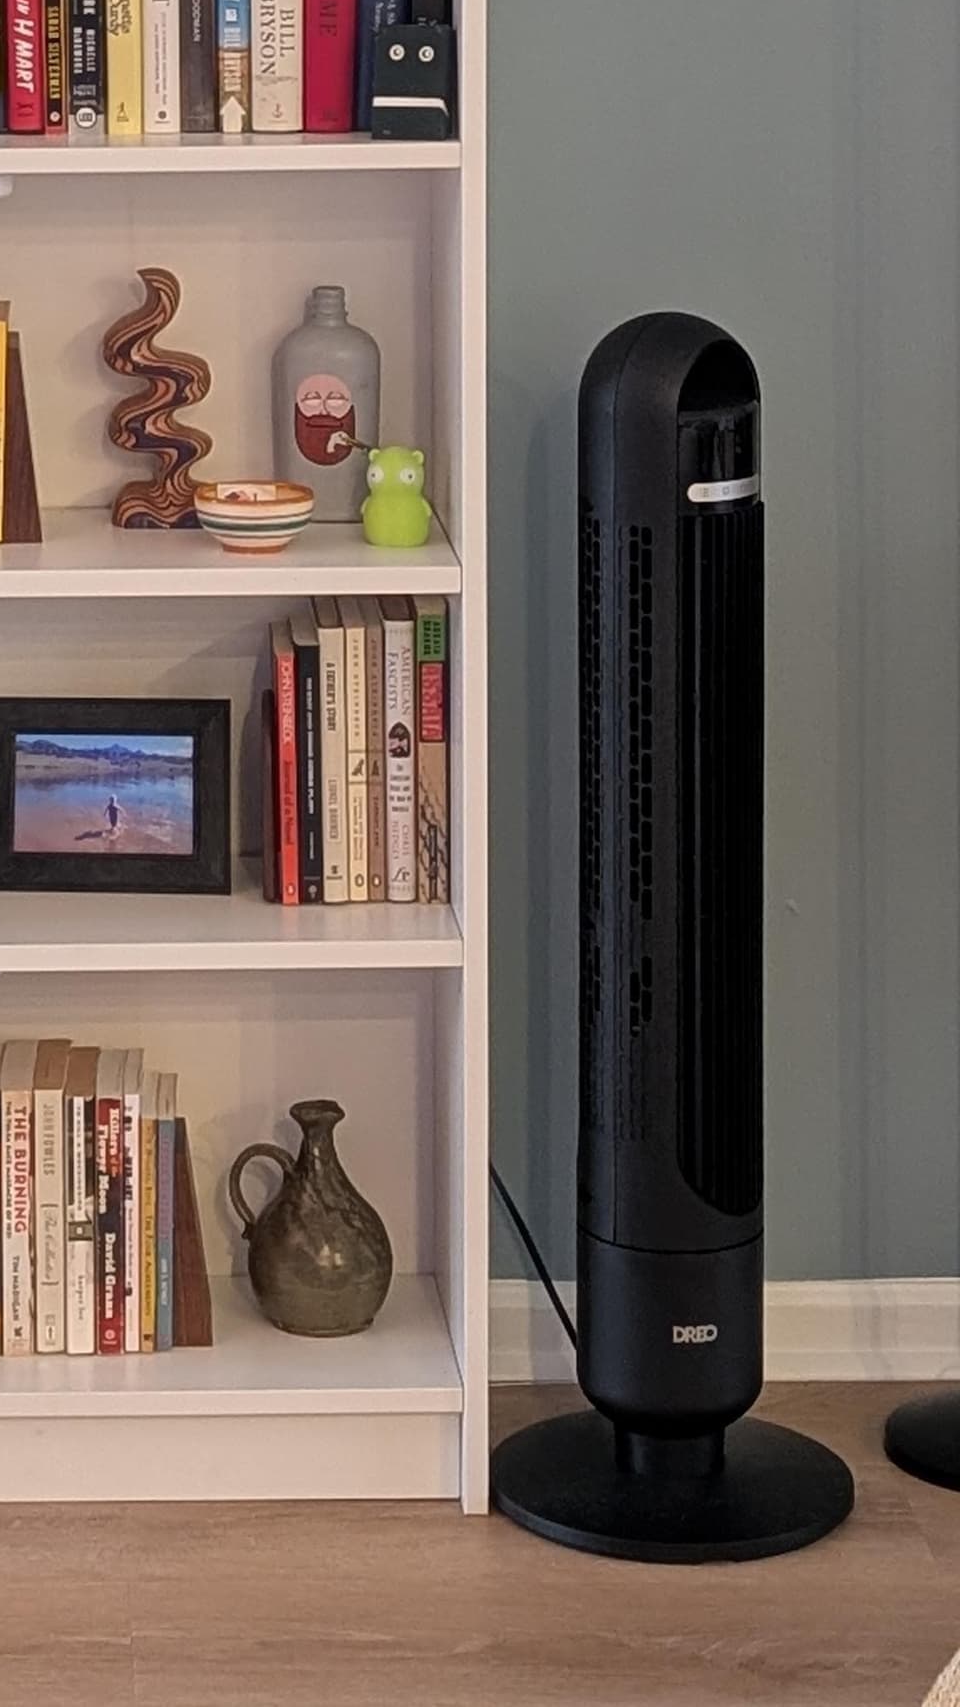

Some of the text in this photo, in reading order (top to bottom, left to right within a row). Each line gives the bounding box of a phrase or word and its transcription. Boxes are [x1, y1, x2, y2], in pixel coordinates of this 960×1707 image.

[14, 19, 33, 35] H
[223, 26, 241, 48] BILL
[279, 8, 295, 58] BILL
[16, 39, 34, 93] MART
[388, 651, 398, 711] FASCISTS
[401, 645, 412, 715] AMERICAN
[109, 1107, 120, 1156] Killers
[14, 1106, 28, 1234] THE BURNING
[97, 1124, 110, 1214] Flower Moon
[105, 1232, 117, 1319] David Grann
[672, 1324, 718, 1344] DREO
